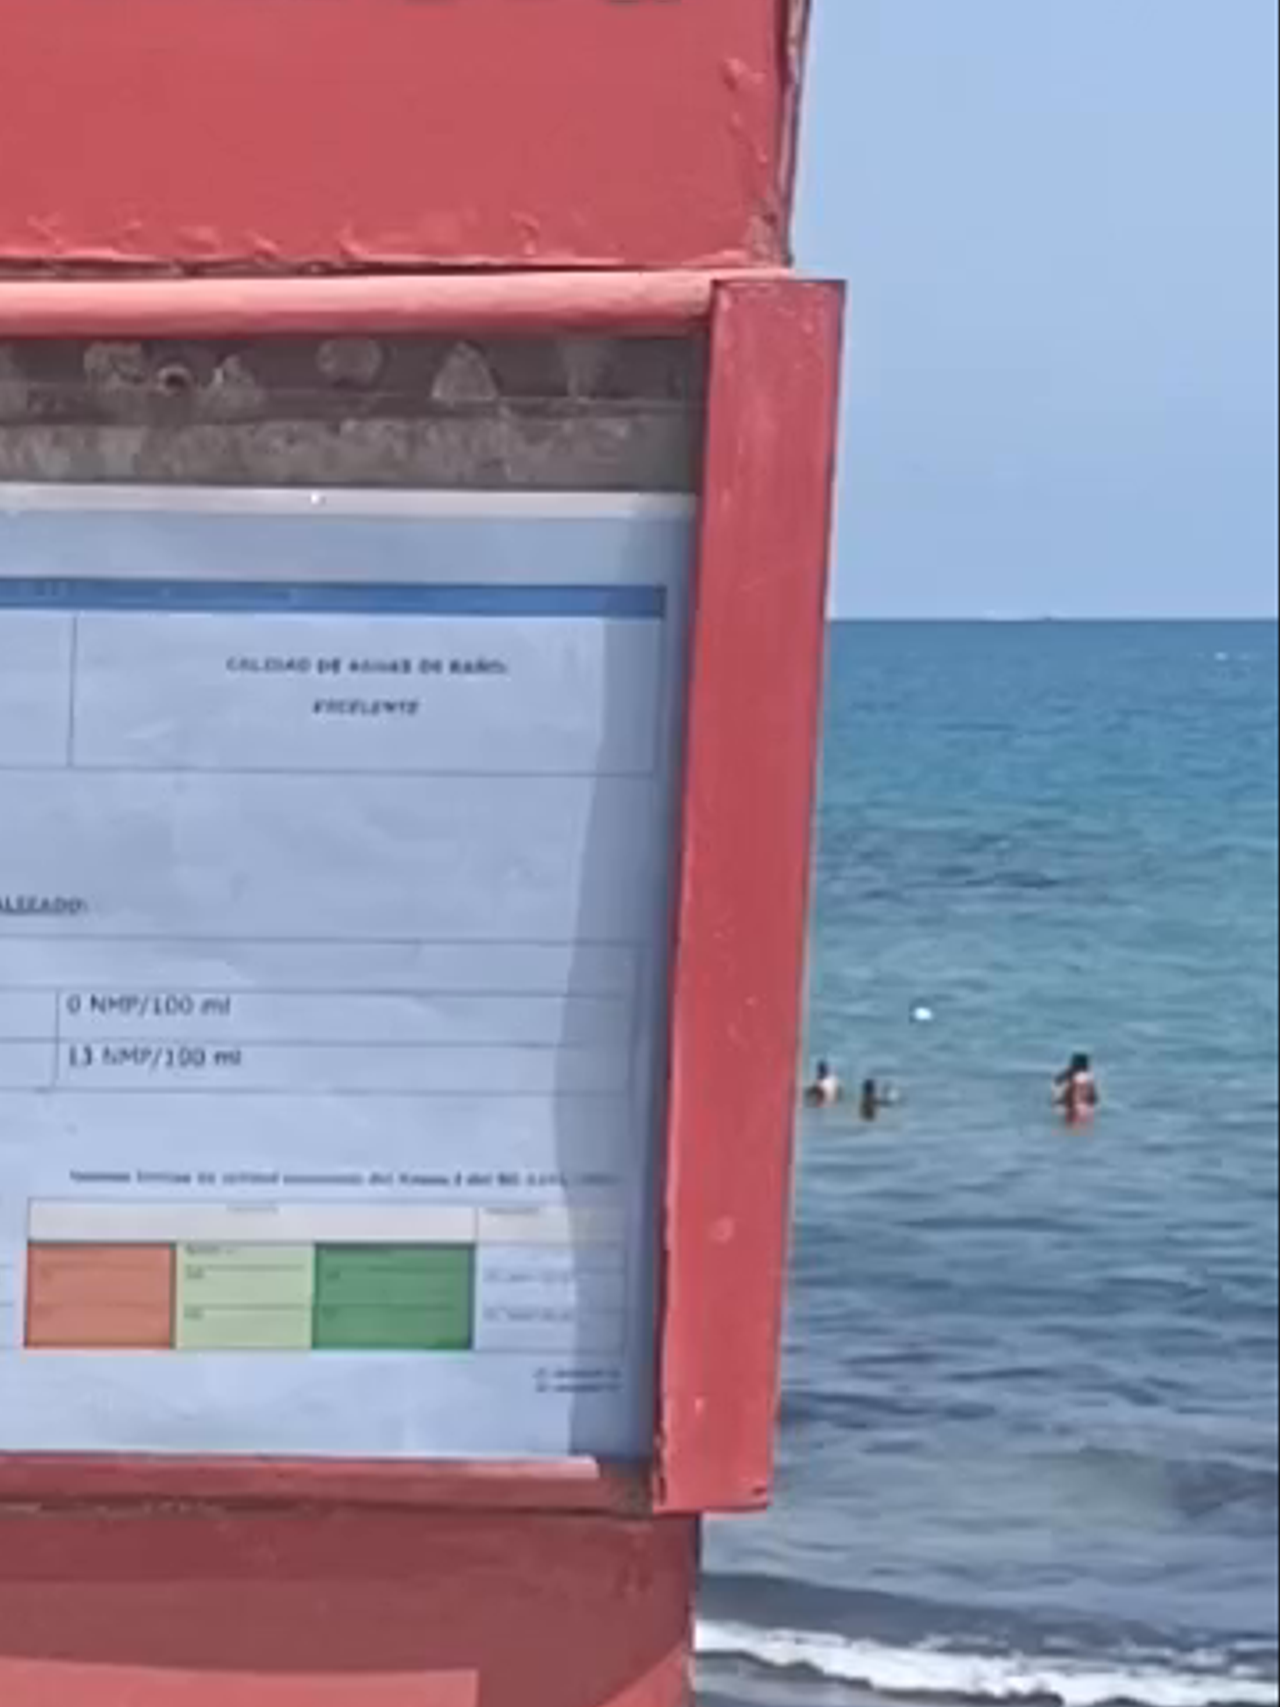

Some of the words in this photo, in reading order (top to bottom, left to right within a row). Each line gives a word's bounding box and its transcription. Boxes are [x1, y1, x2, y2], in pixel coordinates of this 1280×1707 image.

[90, 994, 195, 1017] NMP/100
[200, 995, 231, 1016] ml
[101, 1044, 206, 1068] NMP/100
